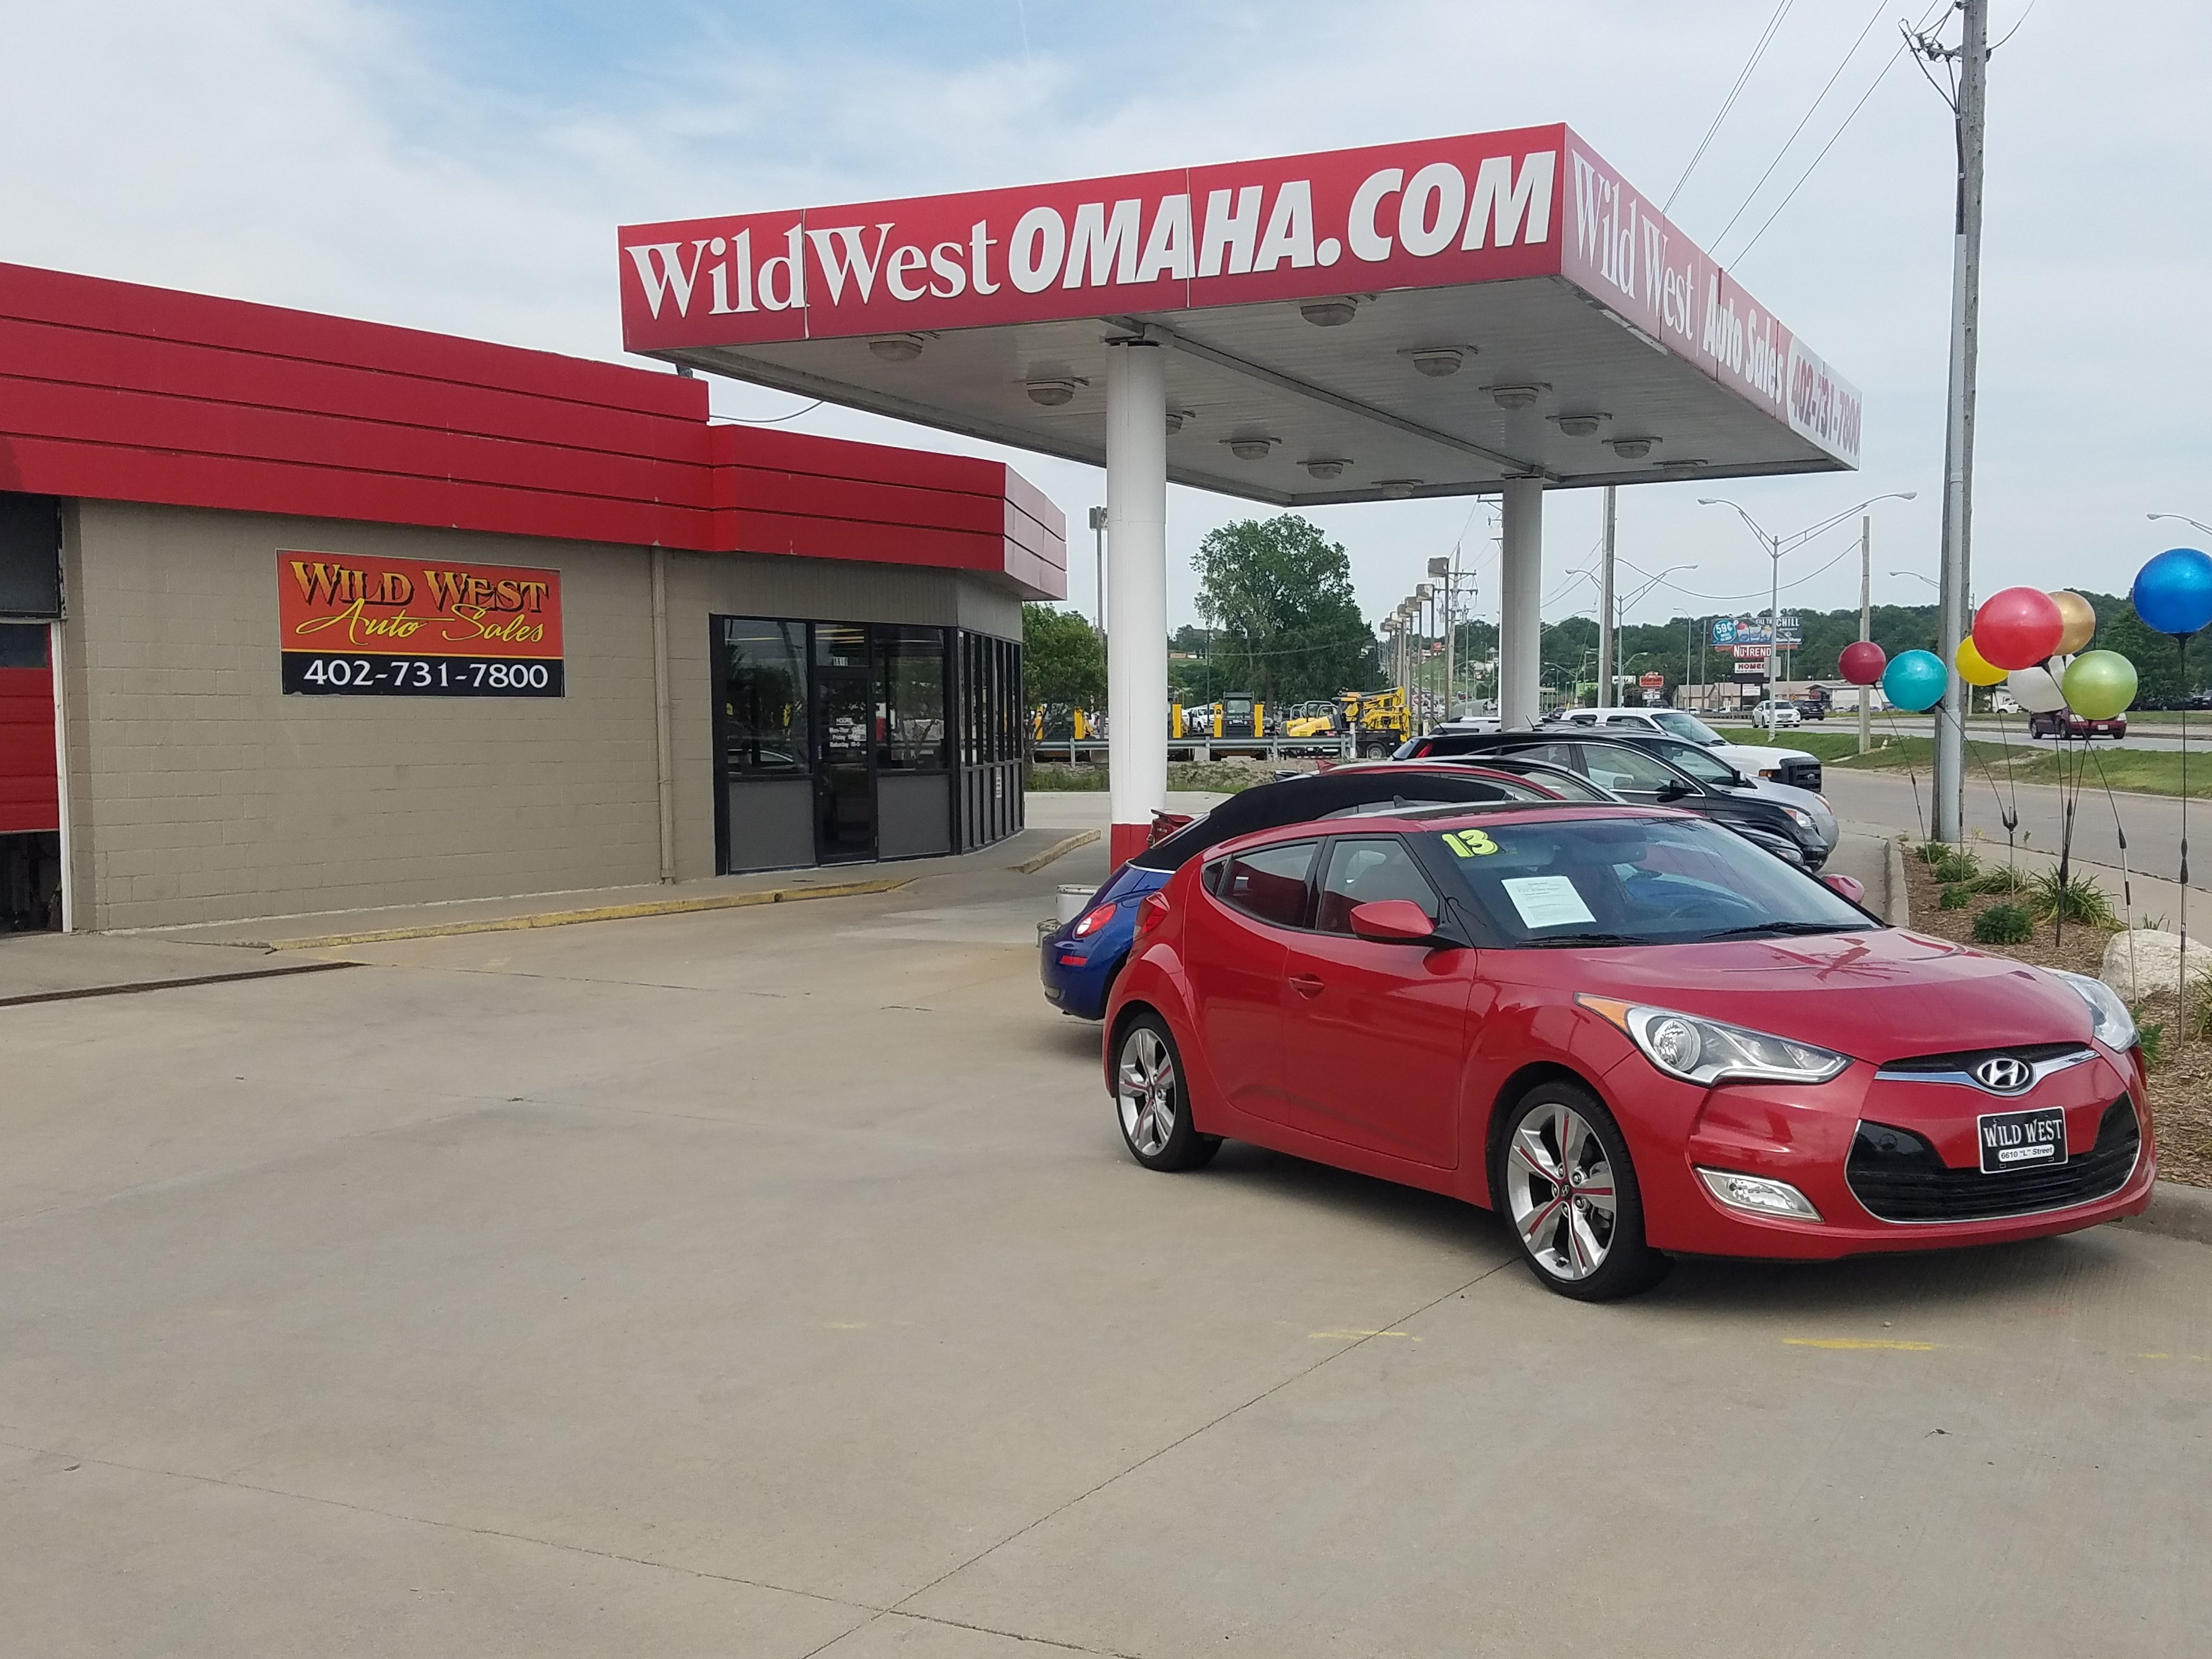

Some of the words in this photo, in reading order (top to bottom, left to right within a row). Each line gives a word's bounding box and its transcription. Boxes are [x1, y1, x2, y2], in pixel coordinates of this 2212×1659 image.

[1572, 148, 1637, 300] Wild
[1641, 215, 1694, 341] West
[1703, 273, 1742, 375] Auto
[1746, 308, 1784, 404] Sales
[1791, 354, 1860, 456] 402-731-7800
[290, 560, 414, 606] WILD
[424, 569, 549, 613] WEST
[295, 597, 455, 645] Auto
[442, 603, 544, 642] Sales
[1776, 618, 1799, 627] CHILL
[303, 659, 548, 688] 402-731-7800
[1441, 829, 1498, 858] 13
[1983, 1123, 2022, 1147] WILD
[2024, 1118, 2062, 1143] WEST
[2033, 1147, 2053, 1155] Street
